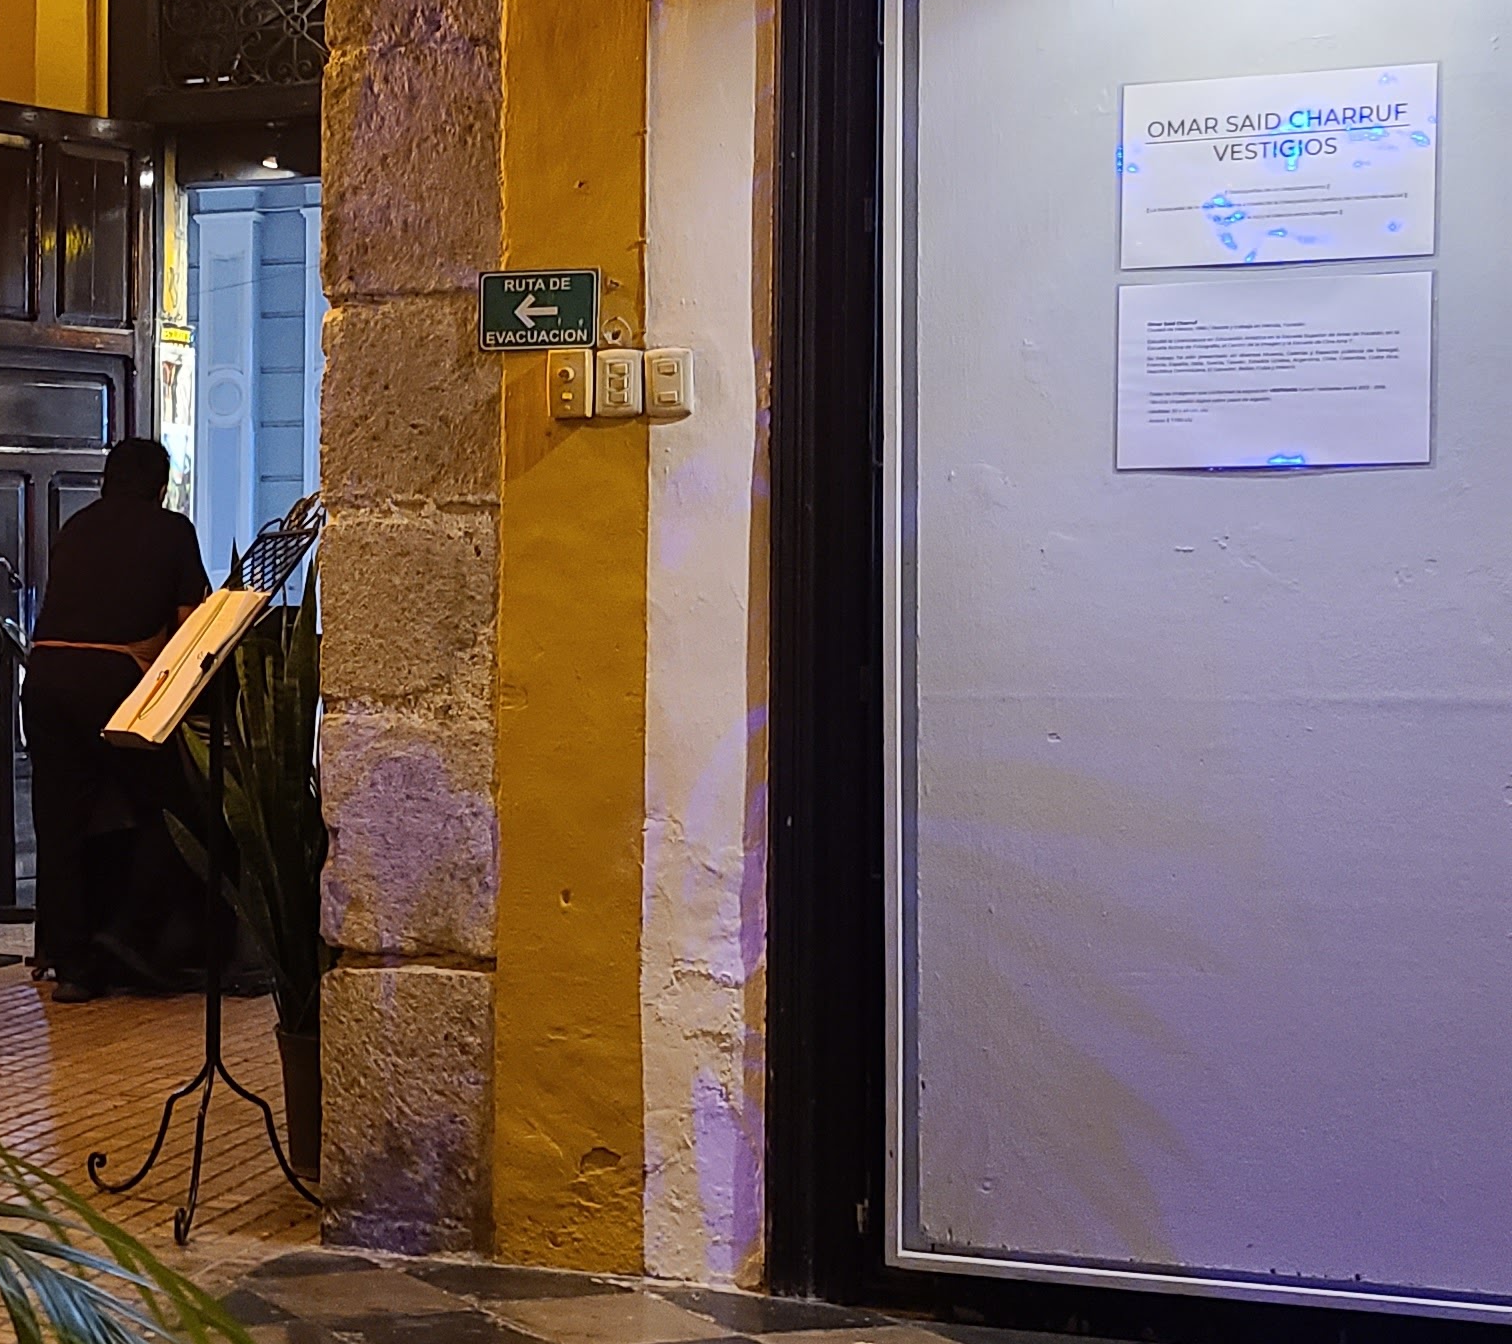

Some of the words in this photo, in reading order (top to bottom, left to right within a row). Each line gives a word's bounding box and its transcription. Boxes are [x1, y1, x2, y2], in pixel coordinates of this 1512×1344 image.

[1147, 116, 1219, 138] OMAR
[1226, 112, 1281, 133] SAID
[1288, 102, 1409, 129] CHARRUF
[1213, 137, 1338, 162] VESTIGIOS
[504, 278, 546, 292] RUTA
[549, 277, 572, 291] DE
[486, 329, 588, 344] EVACUACION
